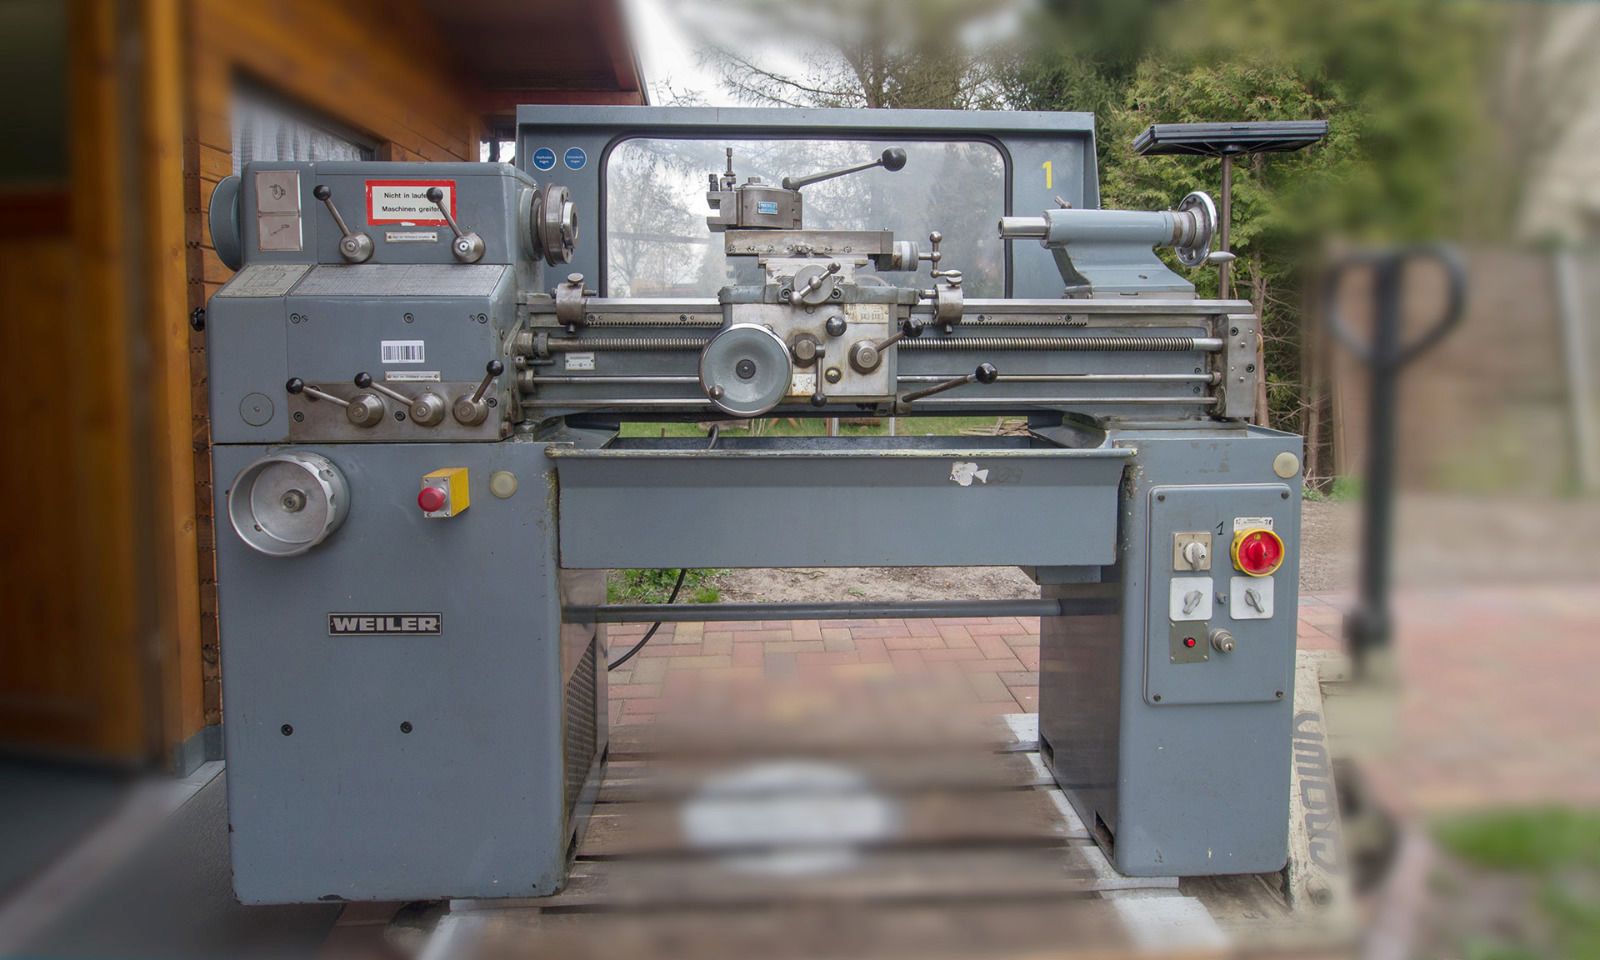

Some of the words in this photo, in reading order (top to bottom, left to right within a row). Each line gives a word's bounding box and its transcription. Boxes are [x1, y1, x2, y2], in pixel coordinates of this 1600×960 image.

[1042, 160, 1052, 190] 1
[1216, 520, 1224, 536] 1
[333, 616, 438, 632] WEILER
